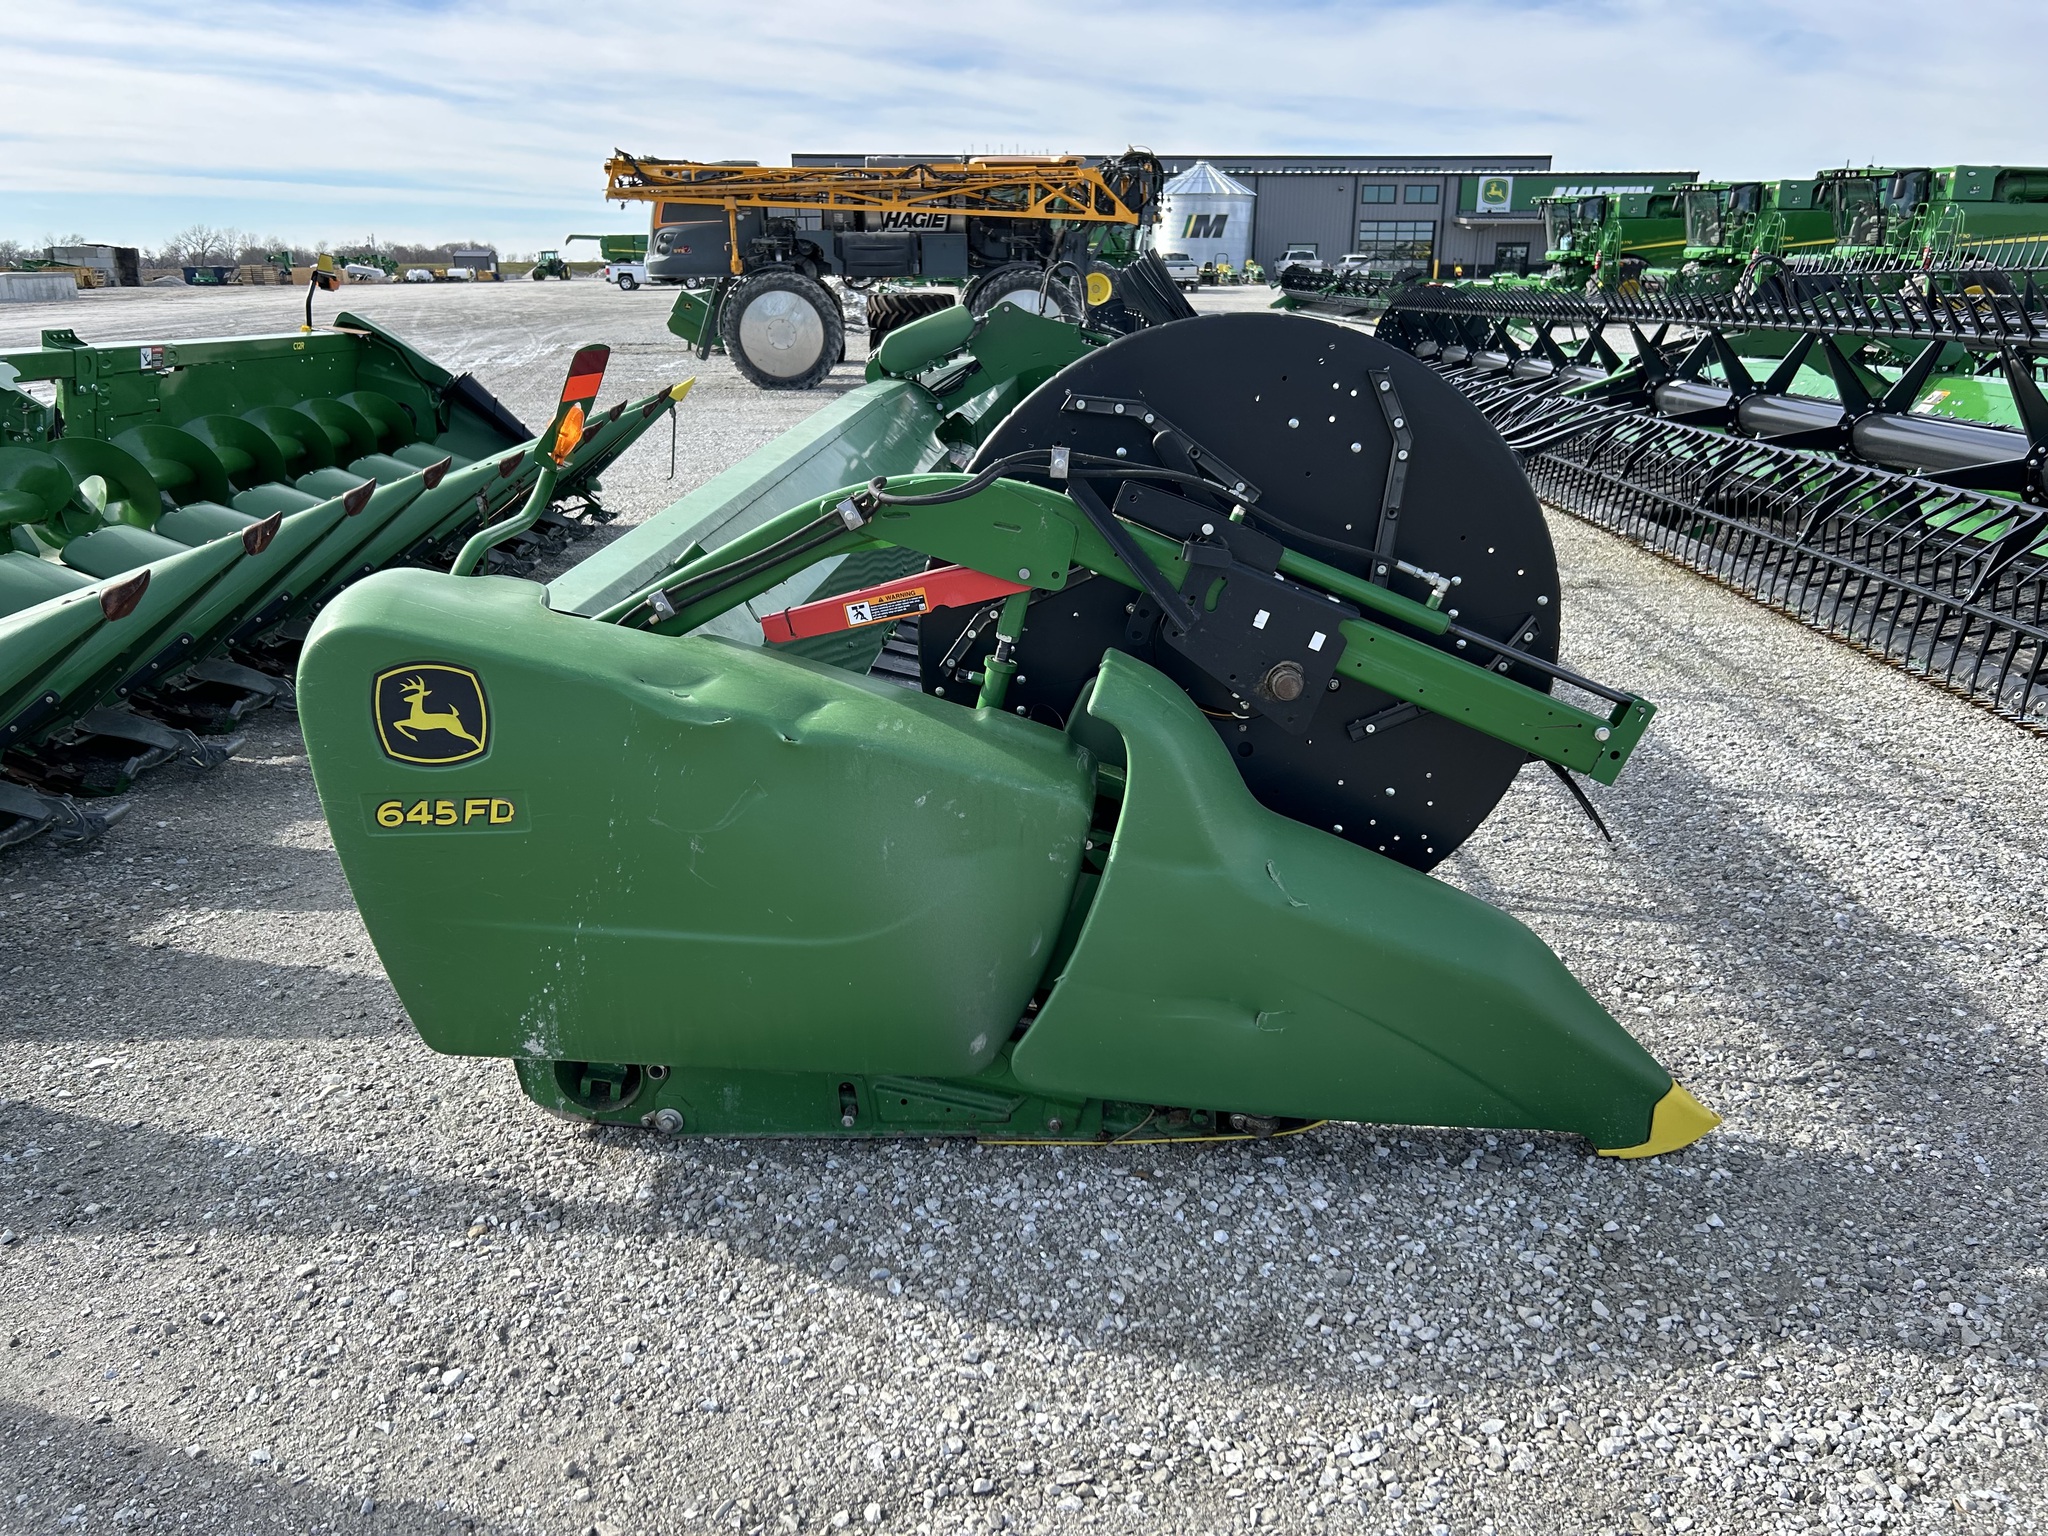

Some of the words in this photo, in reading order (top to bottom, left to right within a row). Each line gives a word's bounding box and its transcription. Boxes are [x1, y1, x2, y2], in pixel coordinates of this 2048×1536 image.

[884, 211, 947, 229] HAGIE
[885, 590, 916, 602] WARNING
[376, 799, 458, 828] 645
[463, 797, 516, 826] FD
